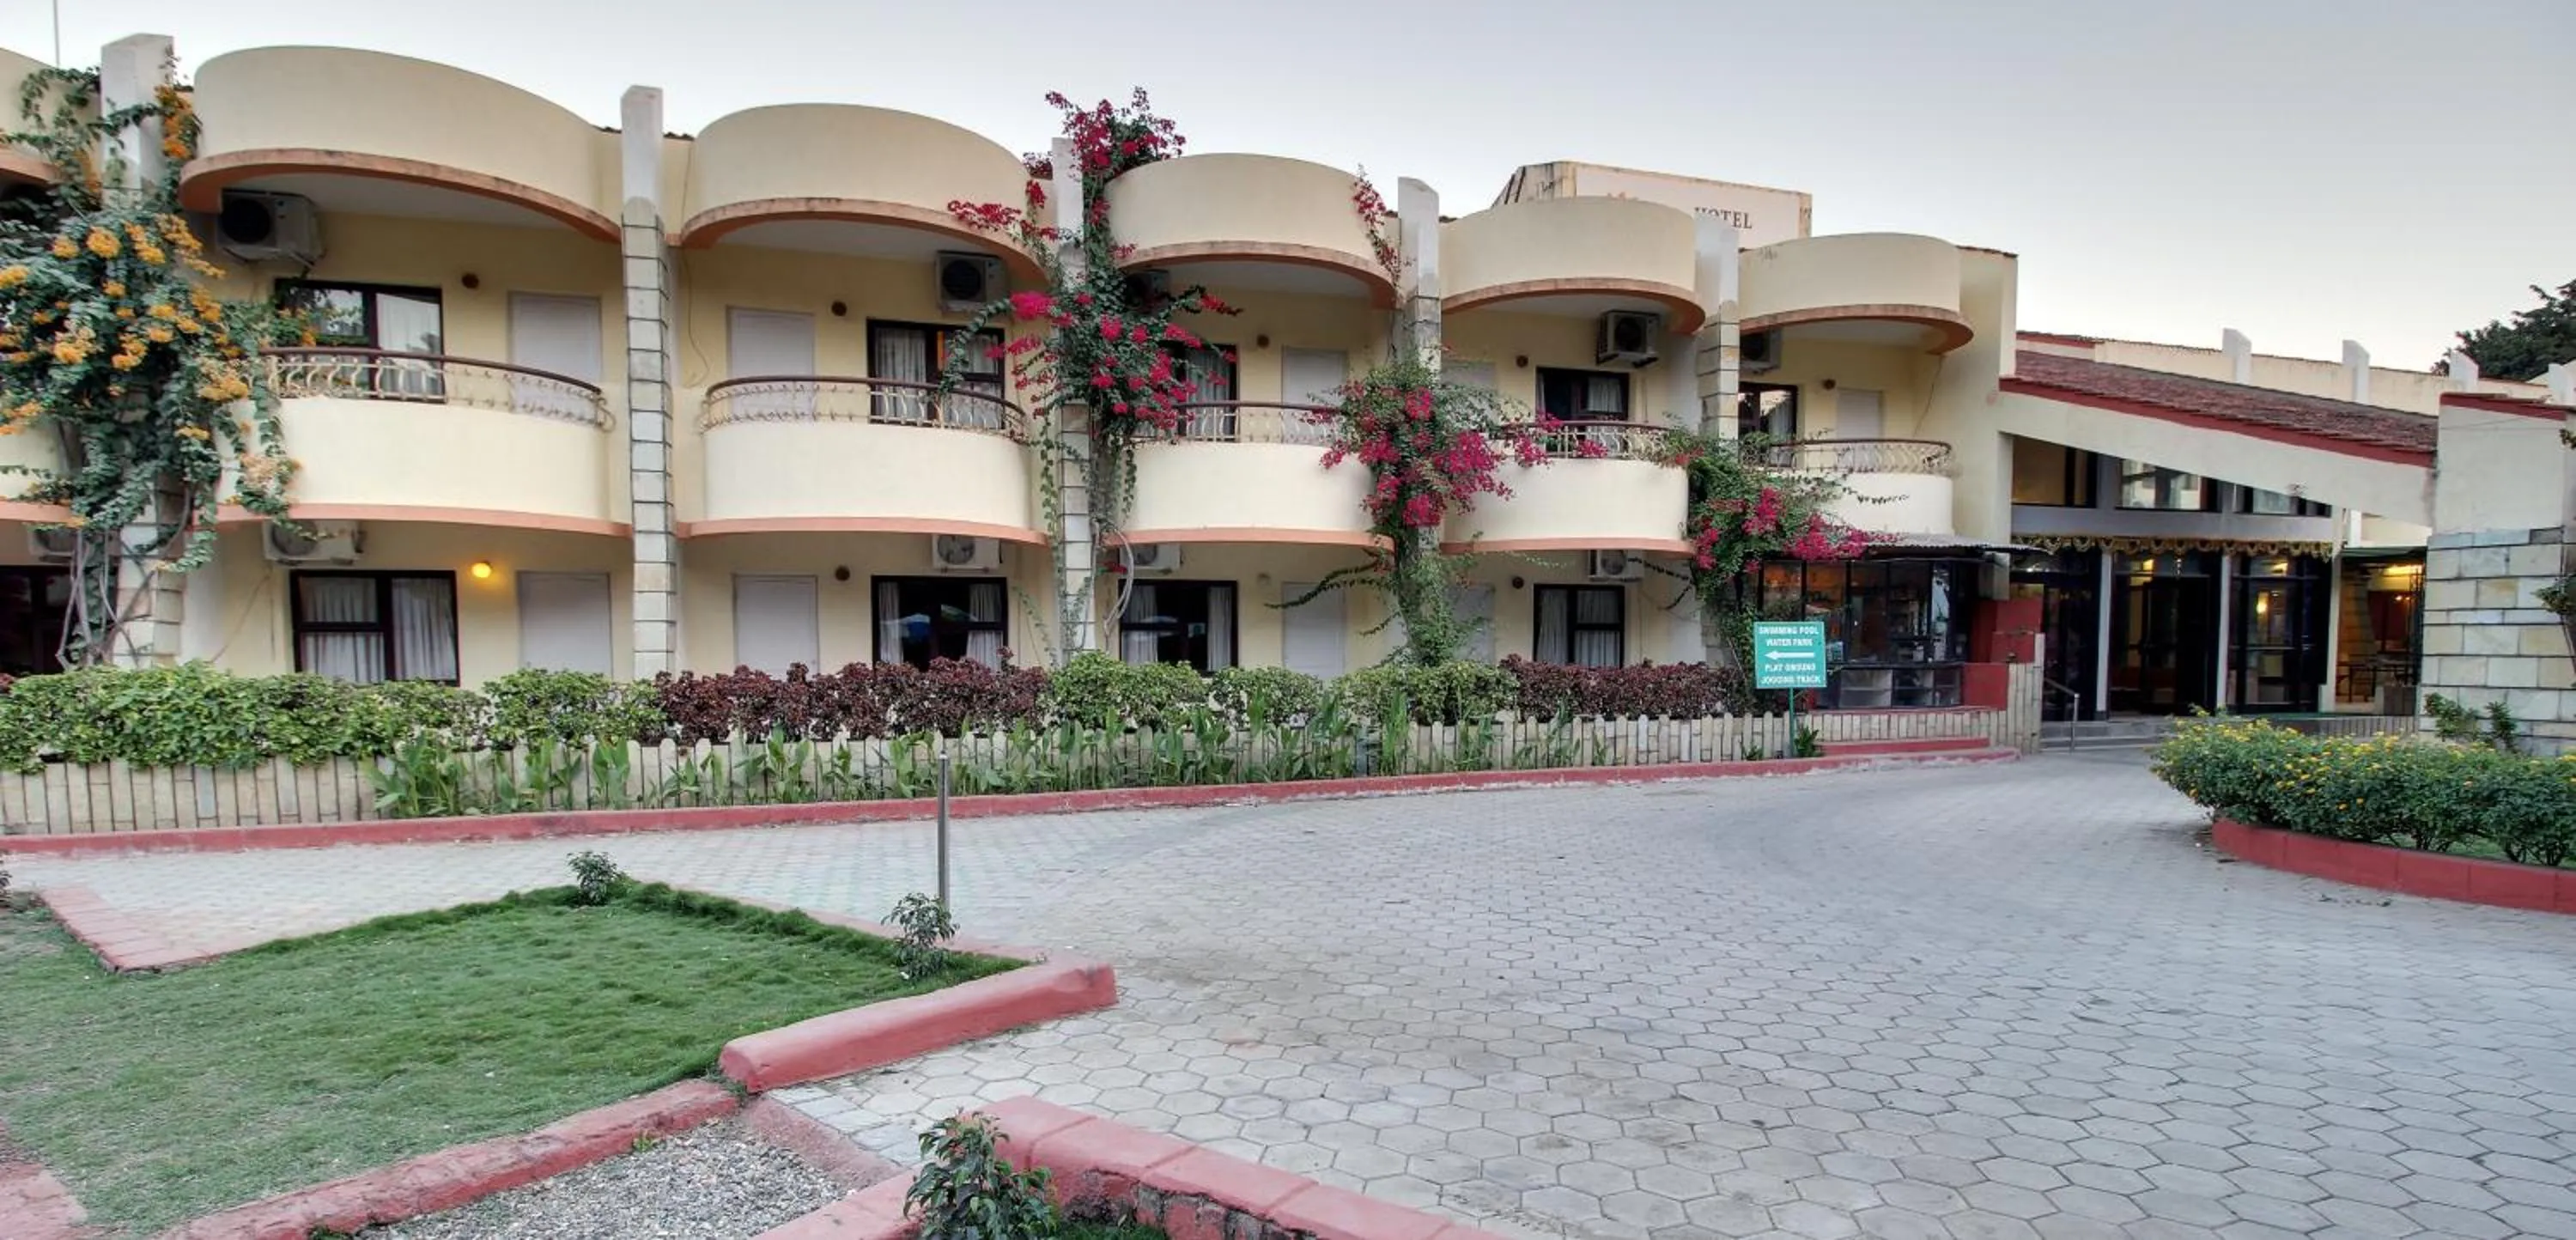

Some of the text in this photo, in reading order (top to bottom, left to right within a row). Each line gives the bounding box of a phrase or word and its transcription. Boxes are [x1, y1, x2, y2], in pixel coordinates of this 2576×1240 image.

[1694, 206, 1753, 229] TEL
[1799, 626, 1820, 635] POOL
[1765, 638, 1814, 647] WATER PARK
[1765, 663, 1783, 672] PLAY
[1796, 675, 1821, 684] TRACK
